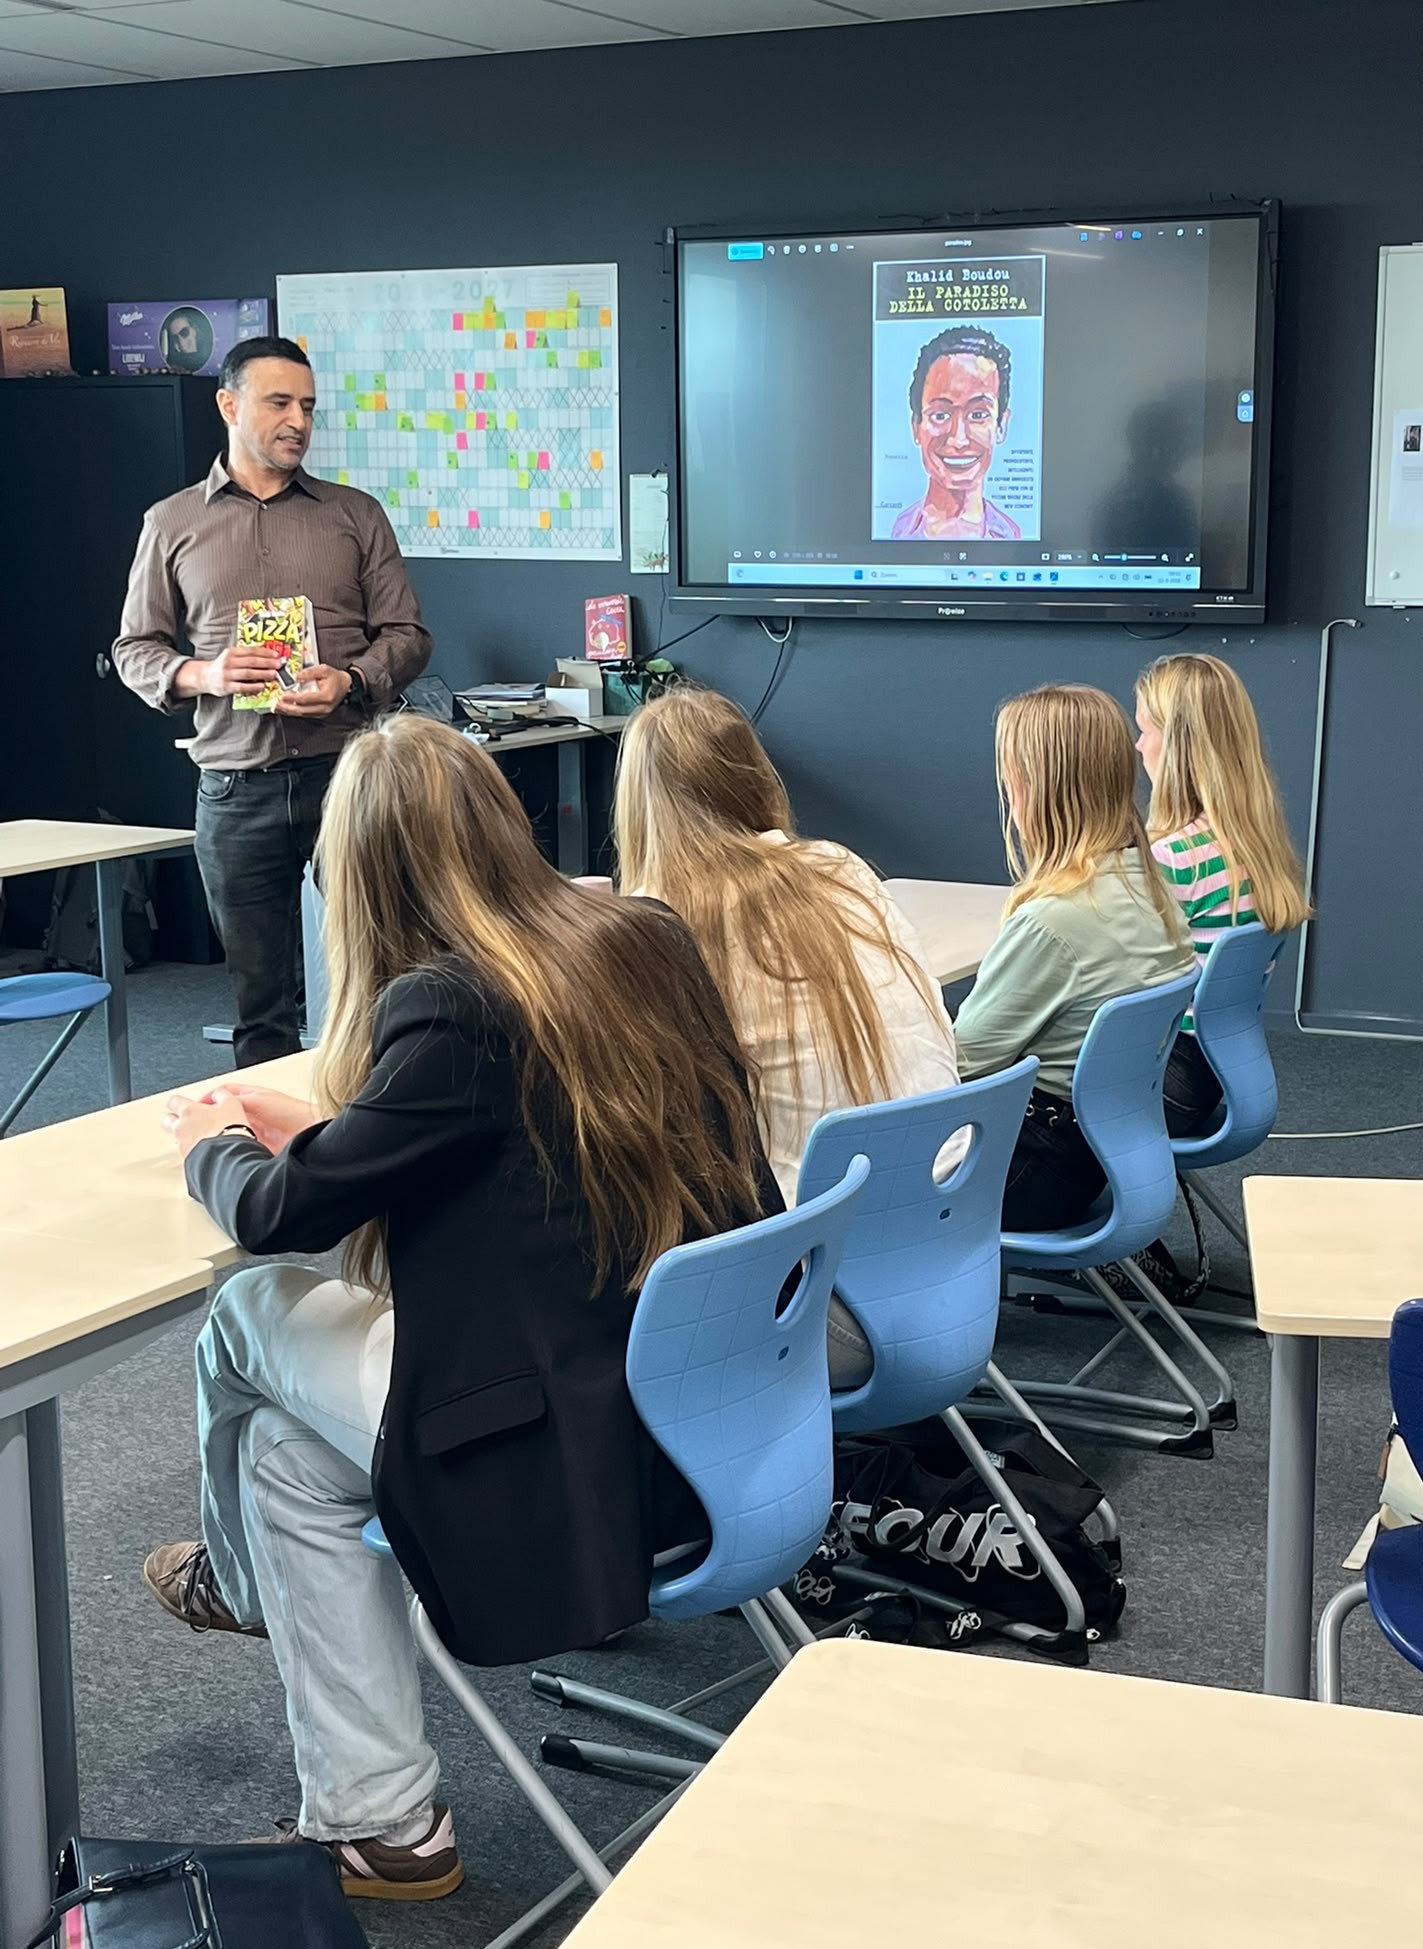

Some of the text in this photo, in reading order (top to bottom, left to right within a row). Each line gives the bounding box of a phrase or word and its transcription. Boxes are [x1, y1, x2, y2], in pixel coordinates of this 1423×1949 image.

[906, 268, 1010, 283] Khalid Boudou
[908, 284, 1009, 299] IL PARADISO
[889, 297, 1027, 313] DELLA COTOLETTA
[243, 619, 301, 645] PIZZA
